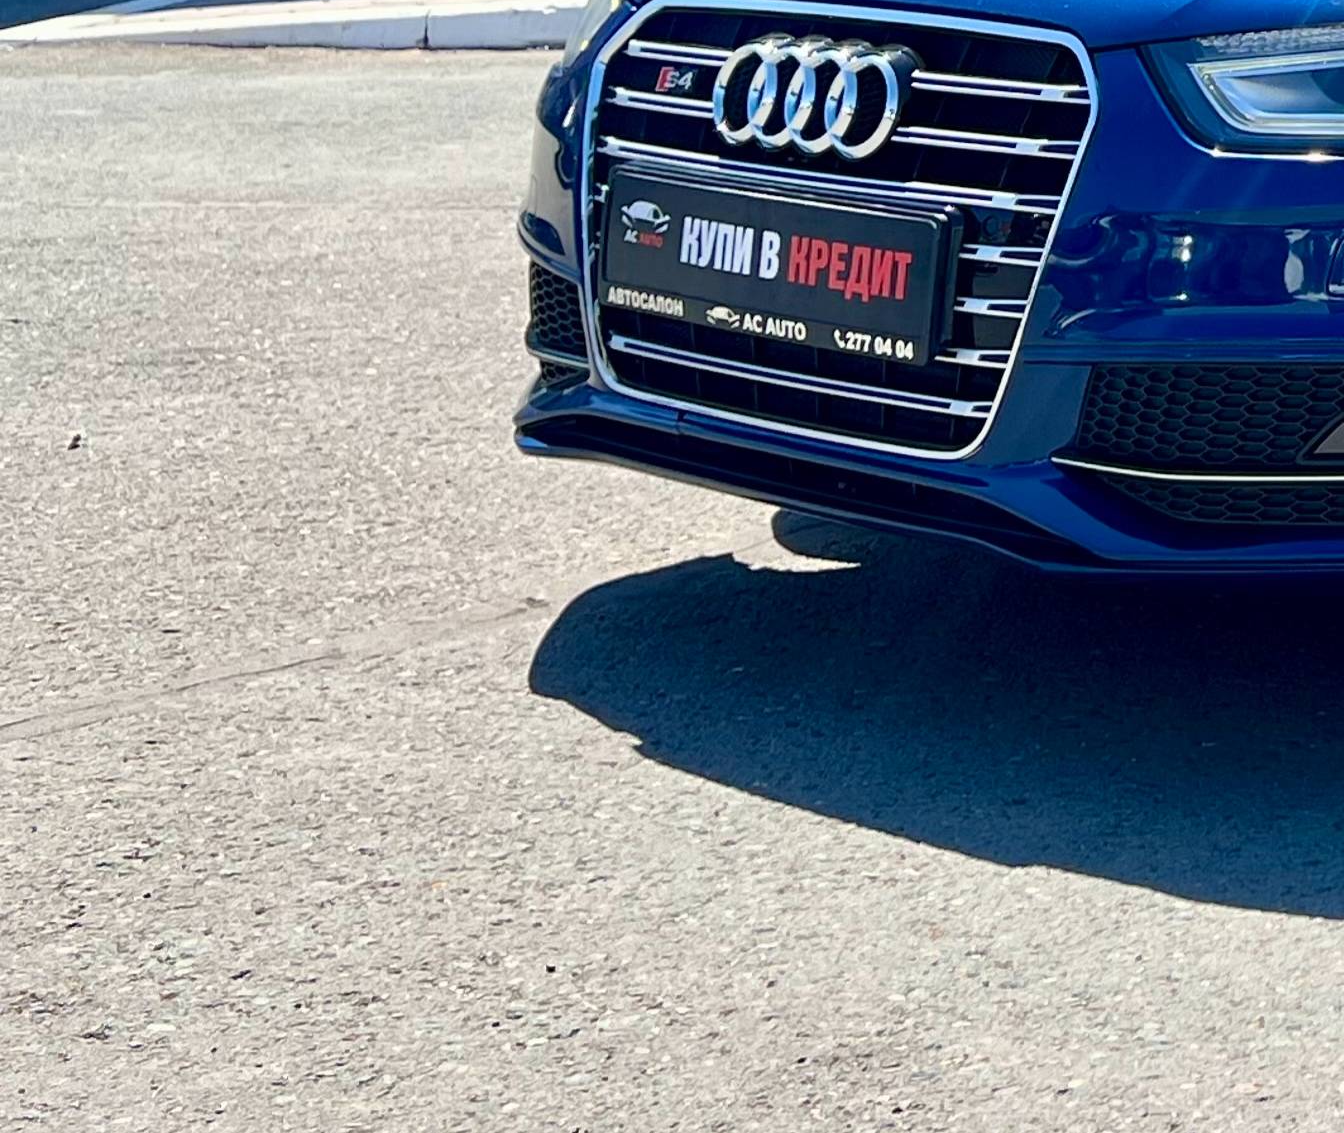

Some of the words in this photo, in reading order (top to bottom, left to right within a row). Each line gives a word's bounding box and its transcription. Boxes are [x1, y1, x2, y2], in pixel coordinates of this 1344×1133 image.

[623, 229, 638, 244] AC
[638, 231, 664, 249] AUTO
[680, 216, 754, 275] КУПИ
[758, 230, 781, 279] В
[787, 235, 912, 302] КРЕДИТ
[607, 286, 684, 317] АВТОСАЛОН
[742, 313, 763, 333] AC
[765, 318, 807, 341] AUTO
[845, 332, 872, 353] 277
[874, 338, 893, 358] 04
[895, 340, 914, 360] 04
